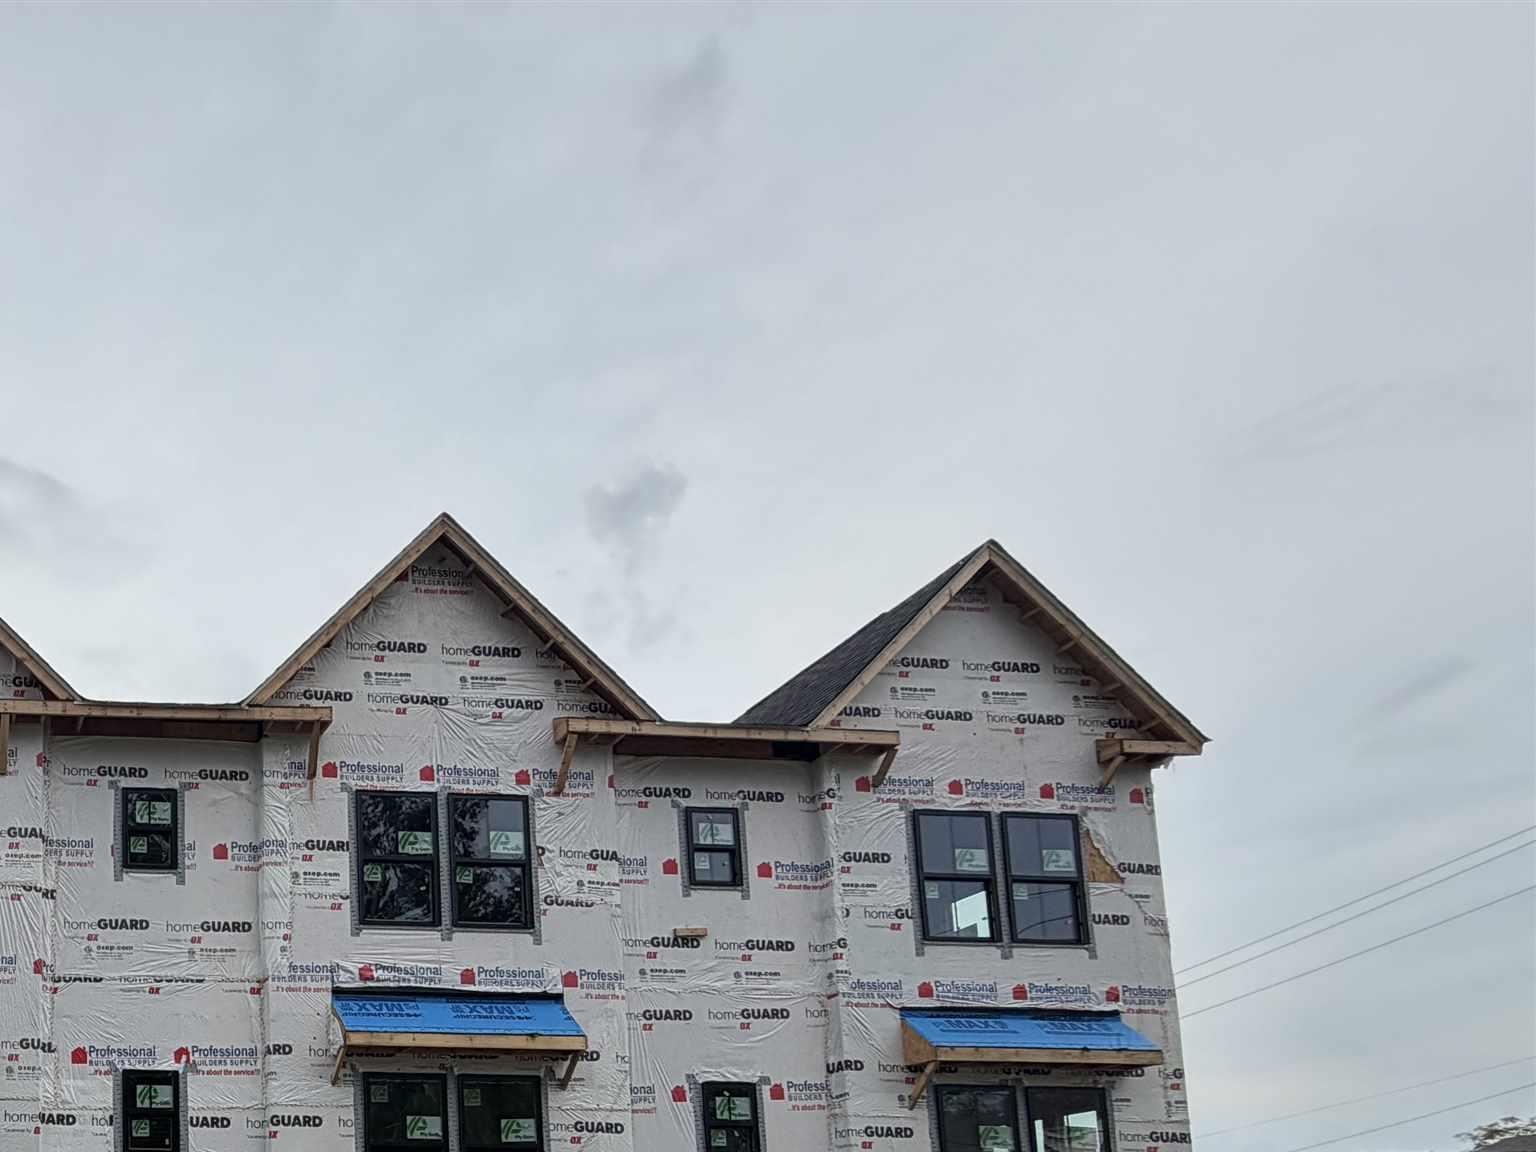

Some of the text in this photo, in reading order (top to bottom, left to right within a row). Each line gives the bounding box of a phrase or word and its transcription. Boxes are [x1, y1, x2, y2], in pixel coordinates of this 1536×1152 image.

[346, 640, 428, 654] homeGUARD
[441, 644, 522, 658] homeGUARD
[962, 661, 1040, 674] homeGUARD
[368, 693, 449, 707] homeGUARD
[464, 697, 544, 710] homeGUARD
[895, 708, 972, 721] homeGUARD
[986, 713, 1064, 726] homeGUARD
[64, 765, 148, 778] homeGUARD
[339, 762, 404, 774] Professional
[339, 762, 404, 775] Professional
[436, 765, 500, 778] Professional
[164, 768, 249, 782] homeGUARD
[964, 779, 1025, 791] Professional
[614, 787, 692, 798] homeGUARD
[706, 790, 784, 802] homeGUARD
[64, 918, 150, 931] homeGUARD
[166, 920, 252, 934] homeGUARD
[715, 939, 795, 951] homeGUARD
[477, 966, 545, 979] Professional
[935, 981, 997, 993] Professional
[708, 1008, 790, 1020] homeGUARD
[89, 1046, 156, 1059] Professional
[835, 1126, 913, 1138] homeGUARD
